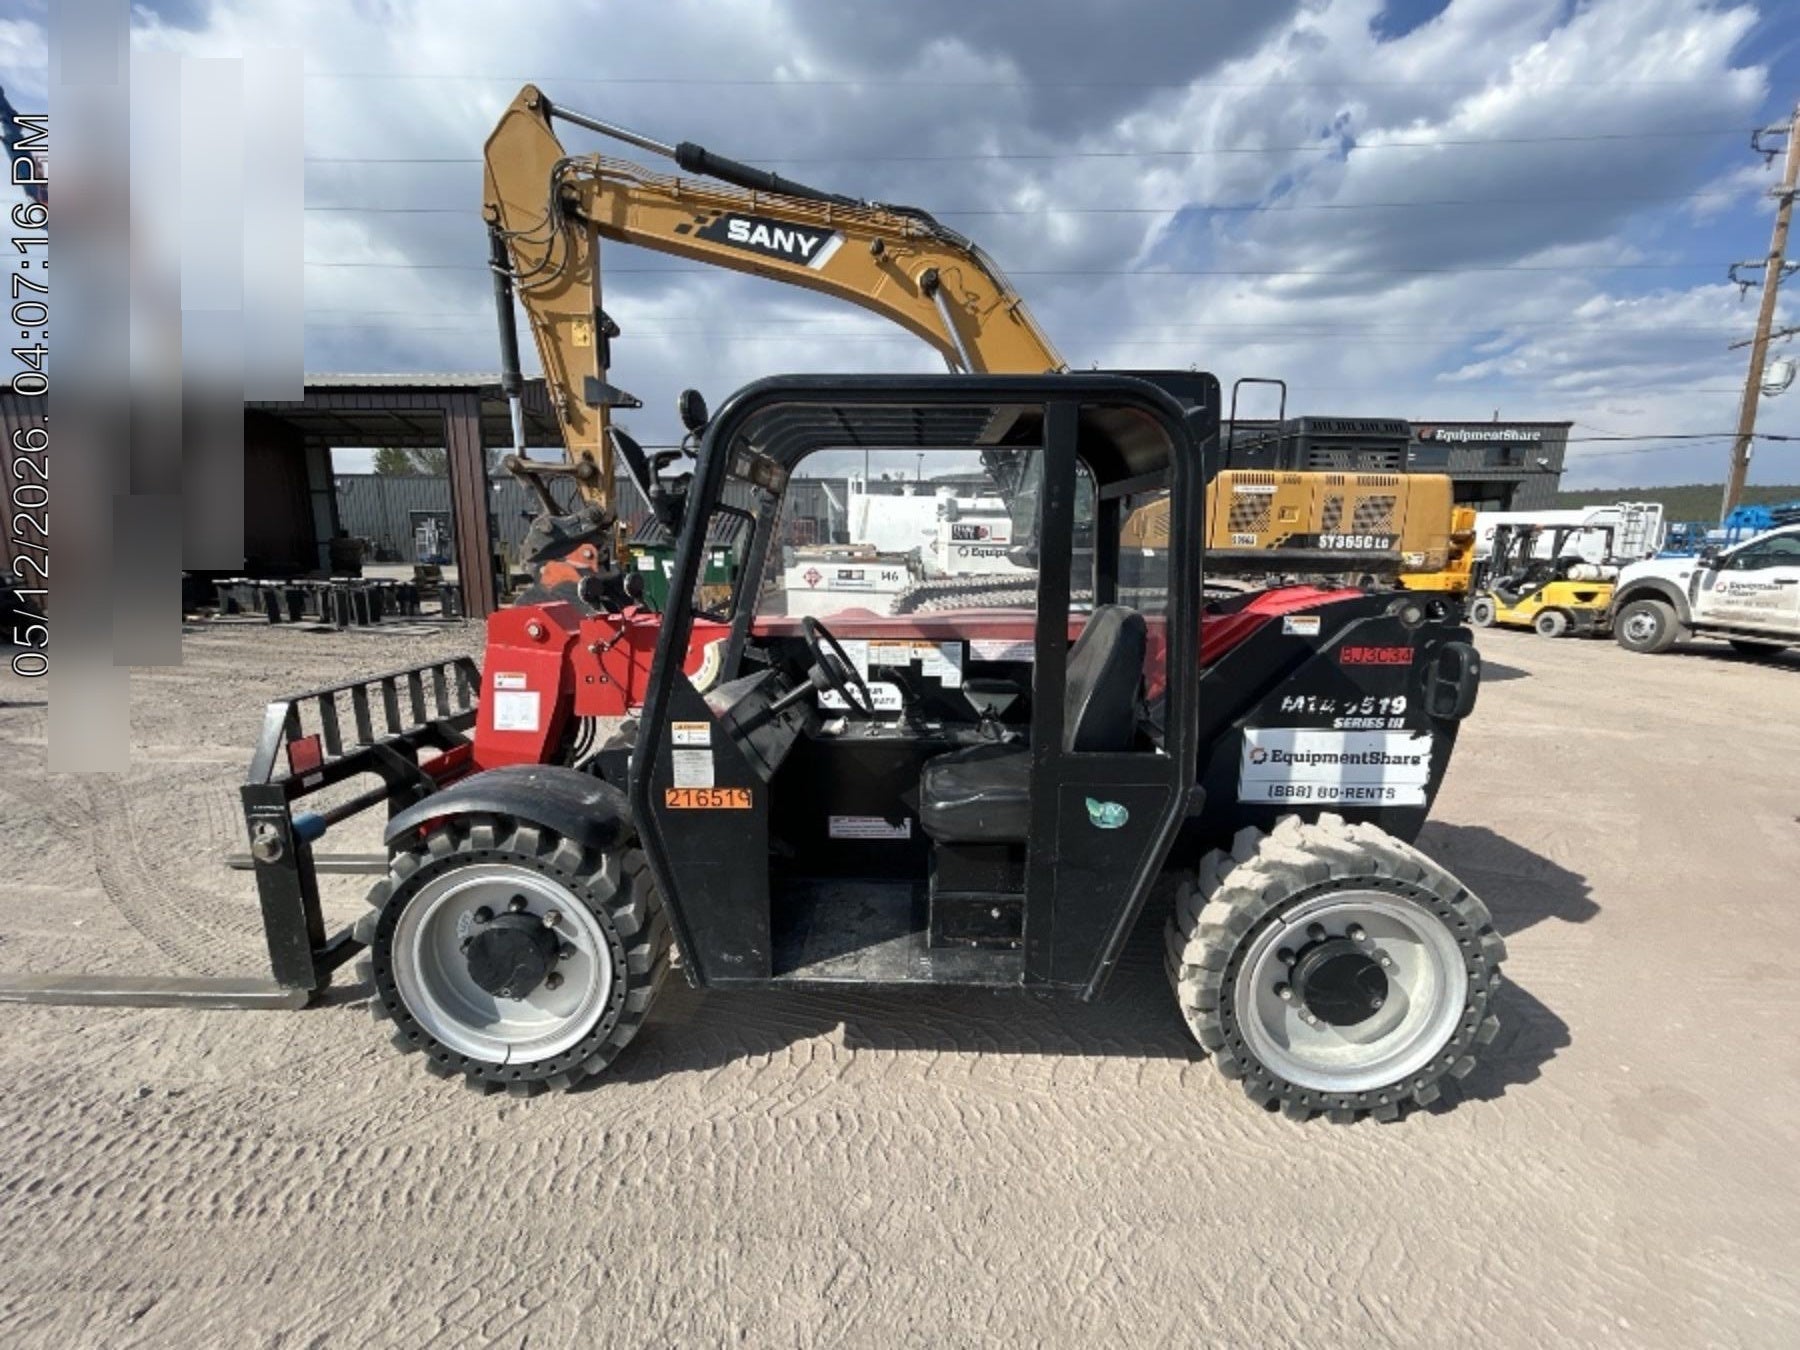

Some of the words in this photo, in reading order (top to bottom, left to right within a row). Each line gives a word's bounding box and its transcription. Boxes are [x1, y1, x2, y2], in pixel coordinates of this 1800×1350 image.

[727, 218, 820, 257] SANY
[1435, 428, 1541, 443] EquipmentShare
[971, 547, 1007, 558] Equip
[1333, 717, 1385, 729] SERIES
[1269, 749, 1421, 766] EquipmentShare
[667, 789, 751, 807] 216519
